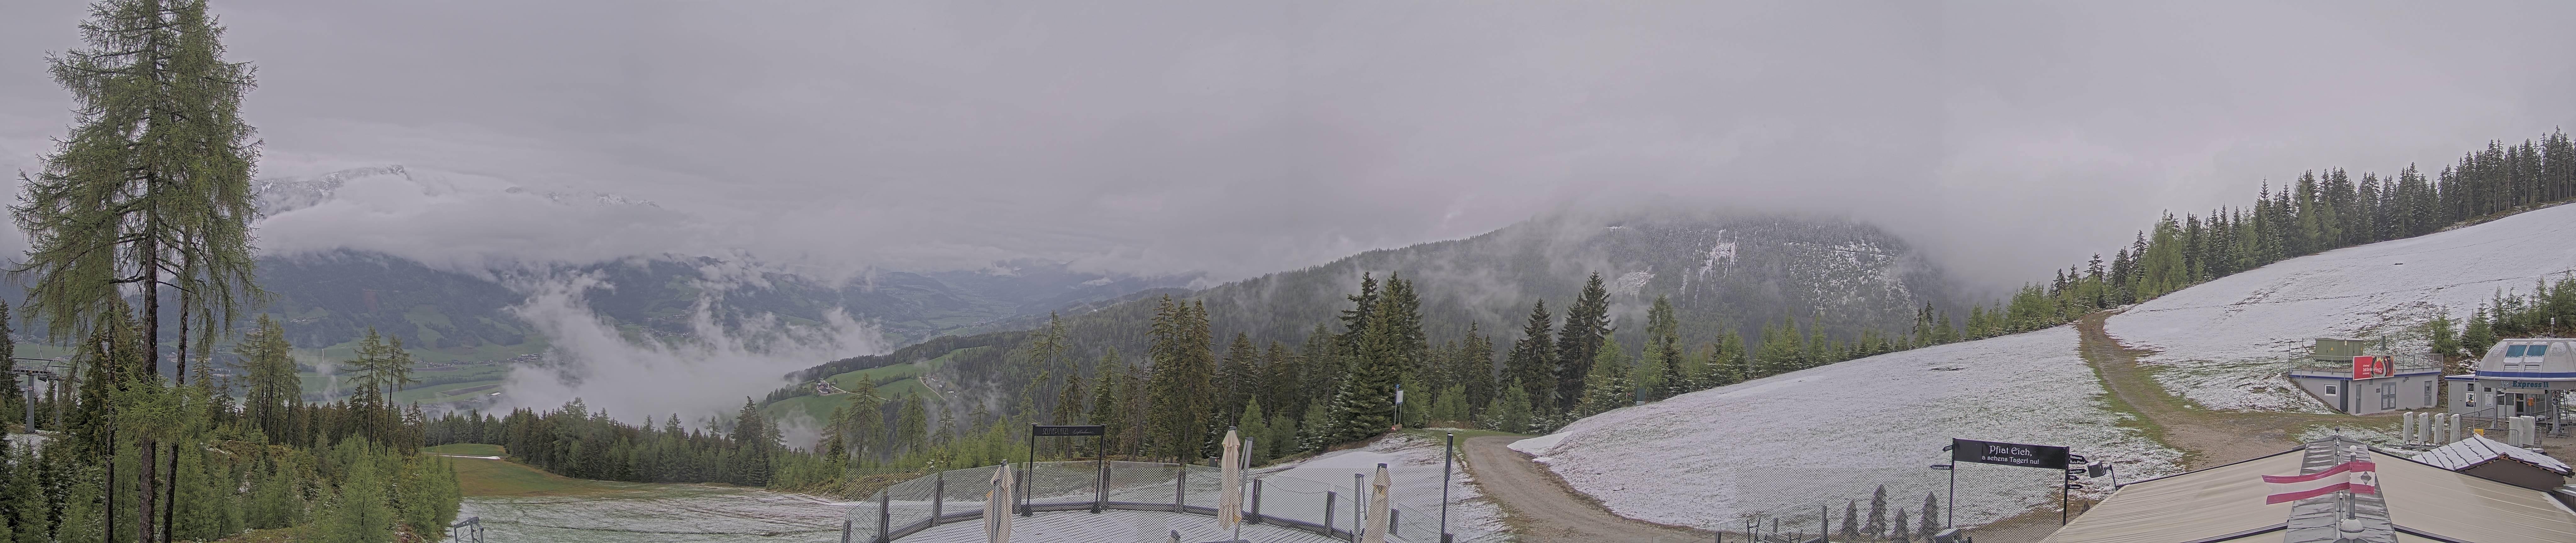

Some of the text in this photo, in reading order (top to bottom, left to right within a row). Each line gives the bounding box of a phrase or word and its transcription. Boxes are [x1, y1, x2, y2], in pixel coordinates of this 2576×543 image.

[2512, 381, 2542, 389] Express
[1989, 445, 2032, 457] Pfiat Eich,
